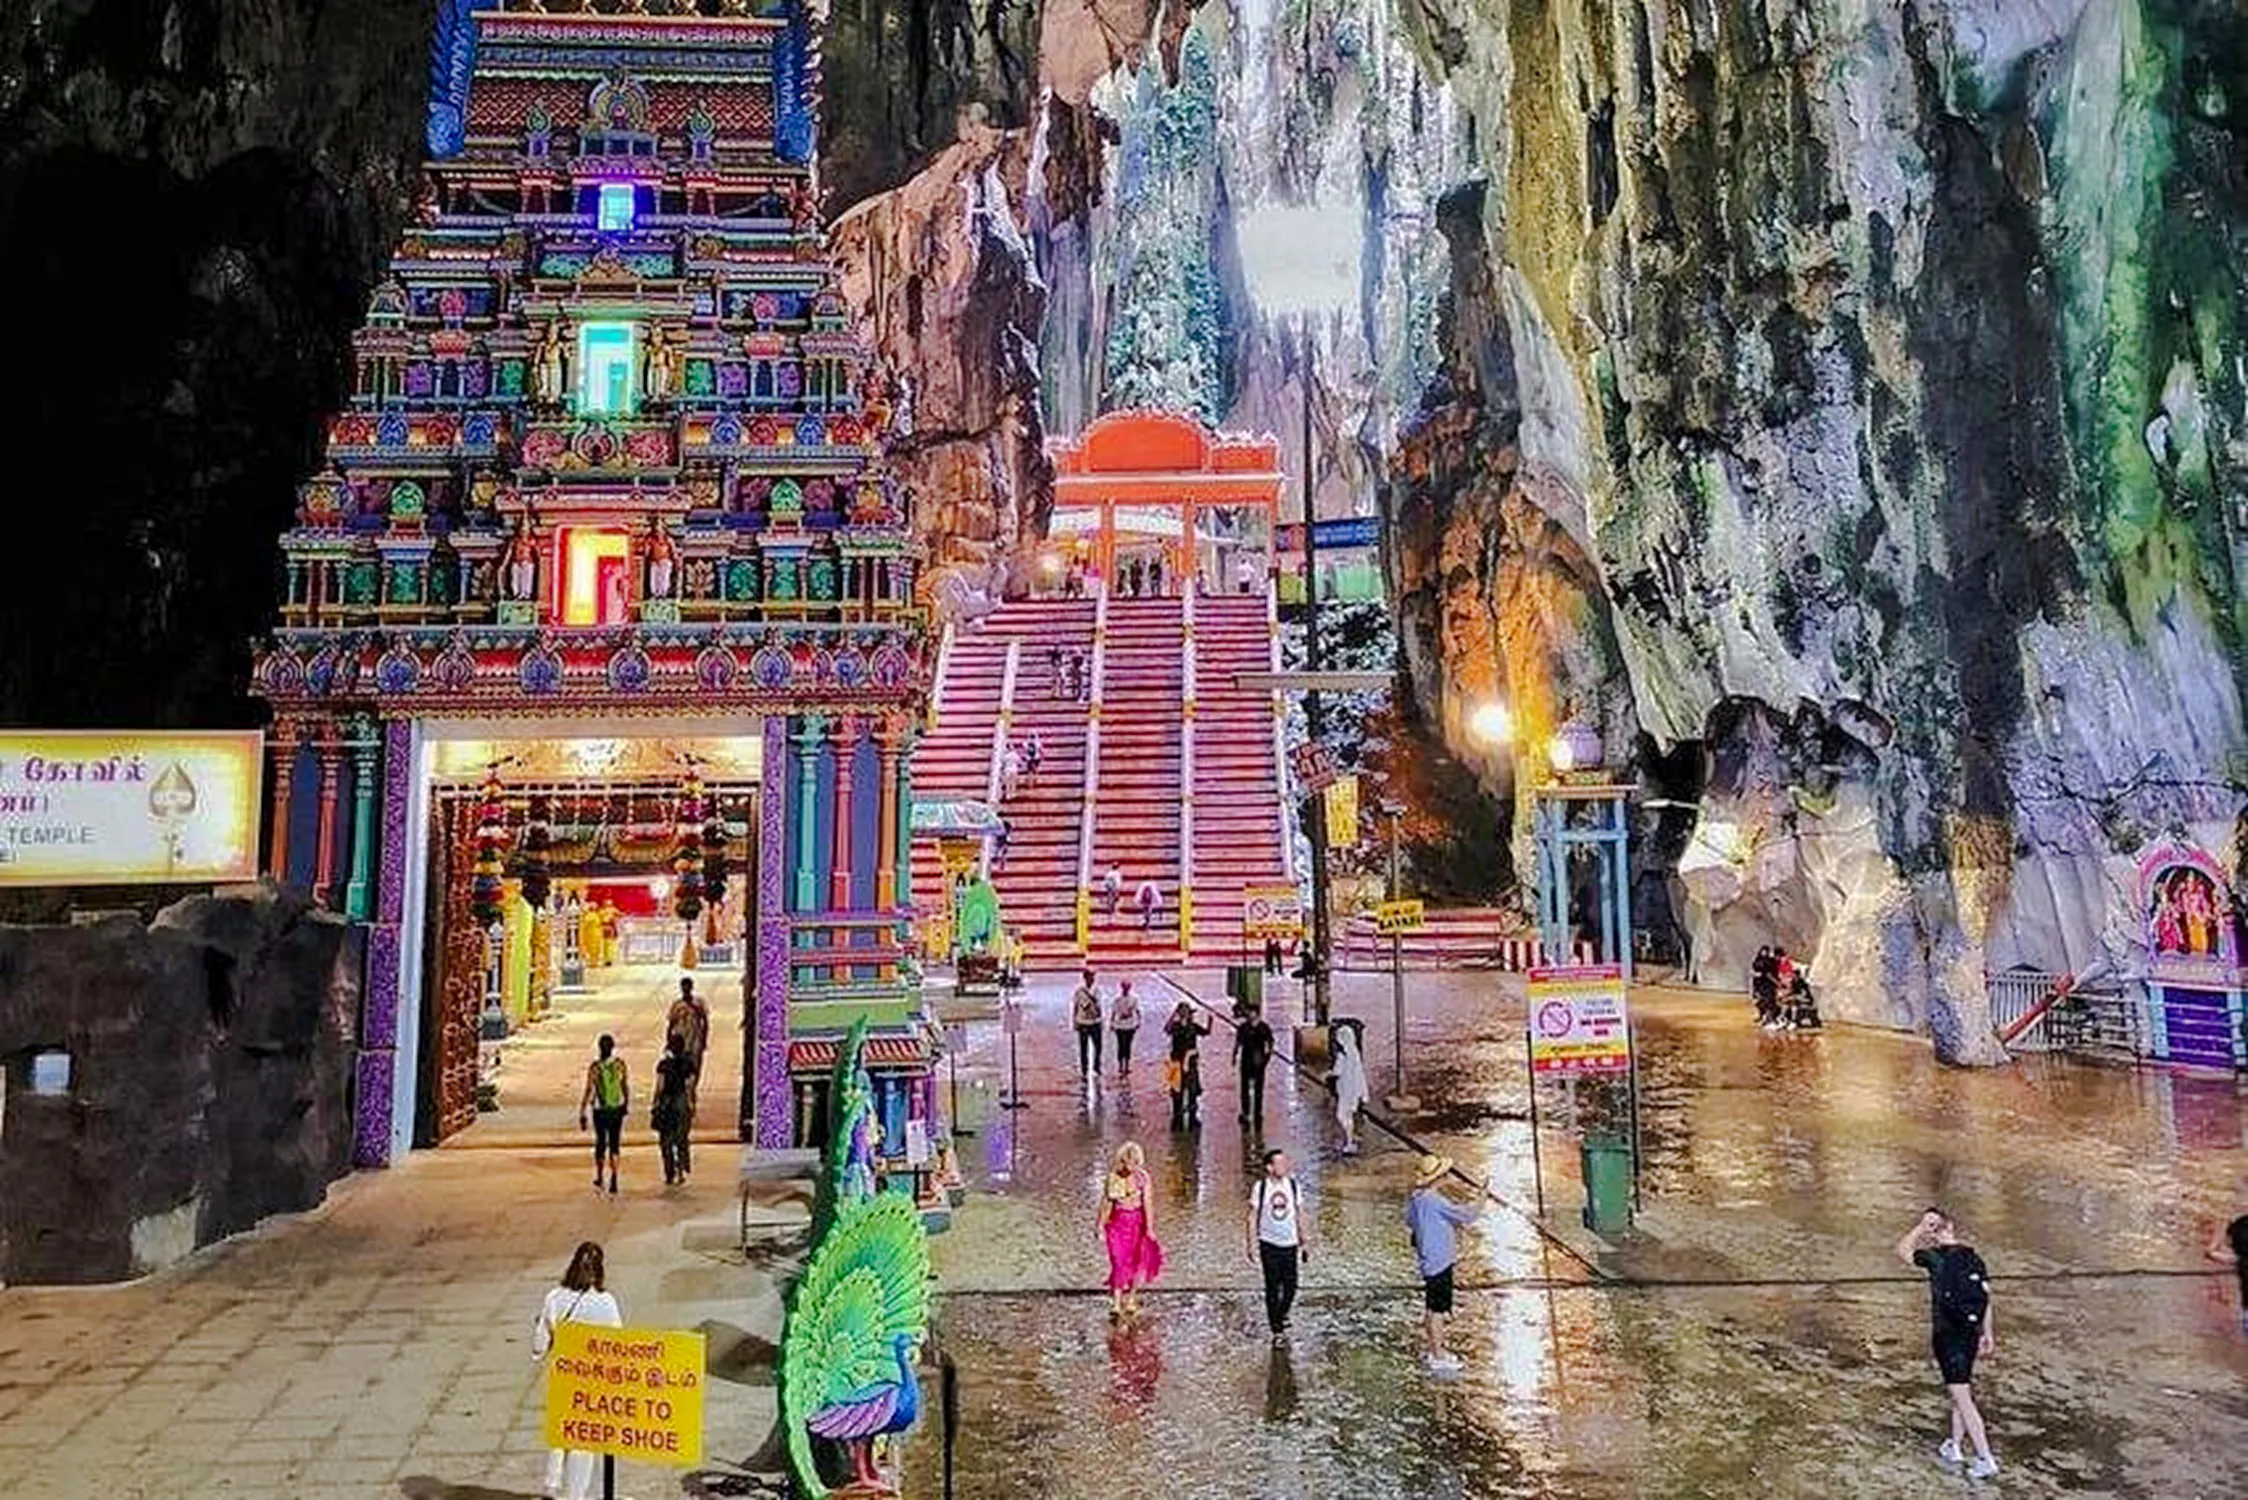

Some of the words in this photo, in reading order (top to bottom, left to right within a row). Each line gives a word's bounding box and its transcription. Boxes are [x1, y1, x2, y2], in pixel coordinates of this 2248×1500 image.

[8, 826, 96, 844] TEMPLE
[572, 1391, 637, 1418] PLACE
[645, 1399, 672, 1421] TO
[562, 1420, 615, 1442] KEEP
[621, 1427, 679, 1452] SHOE
